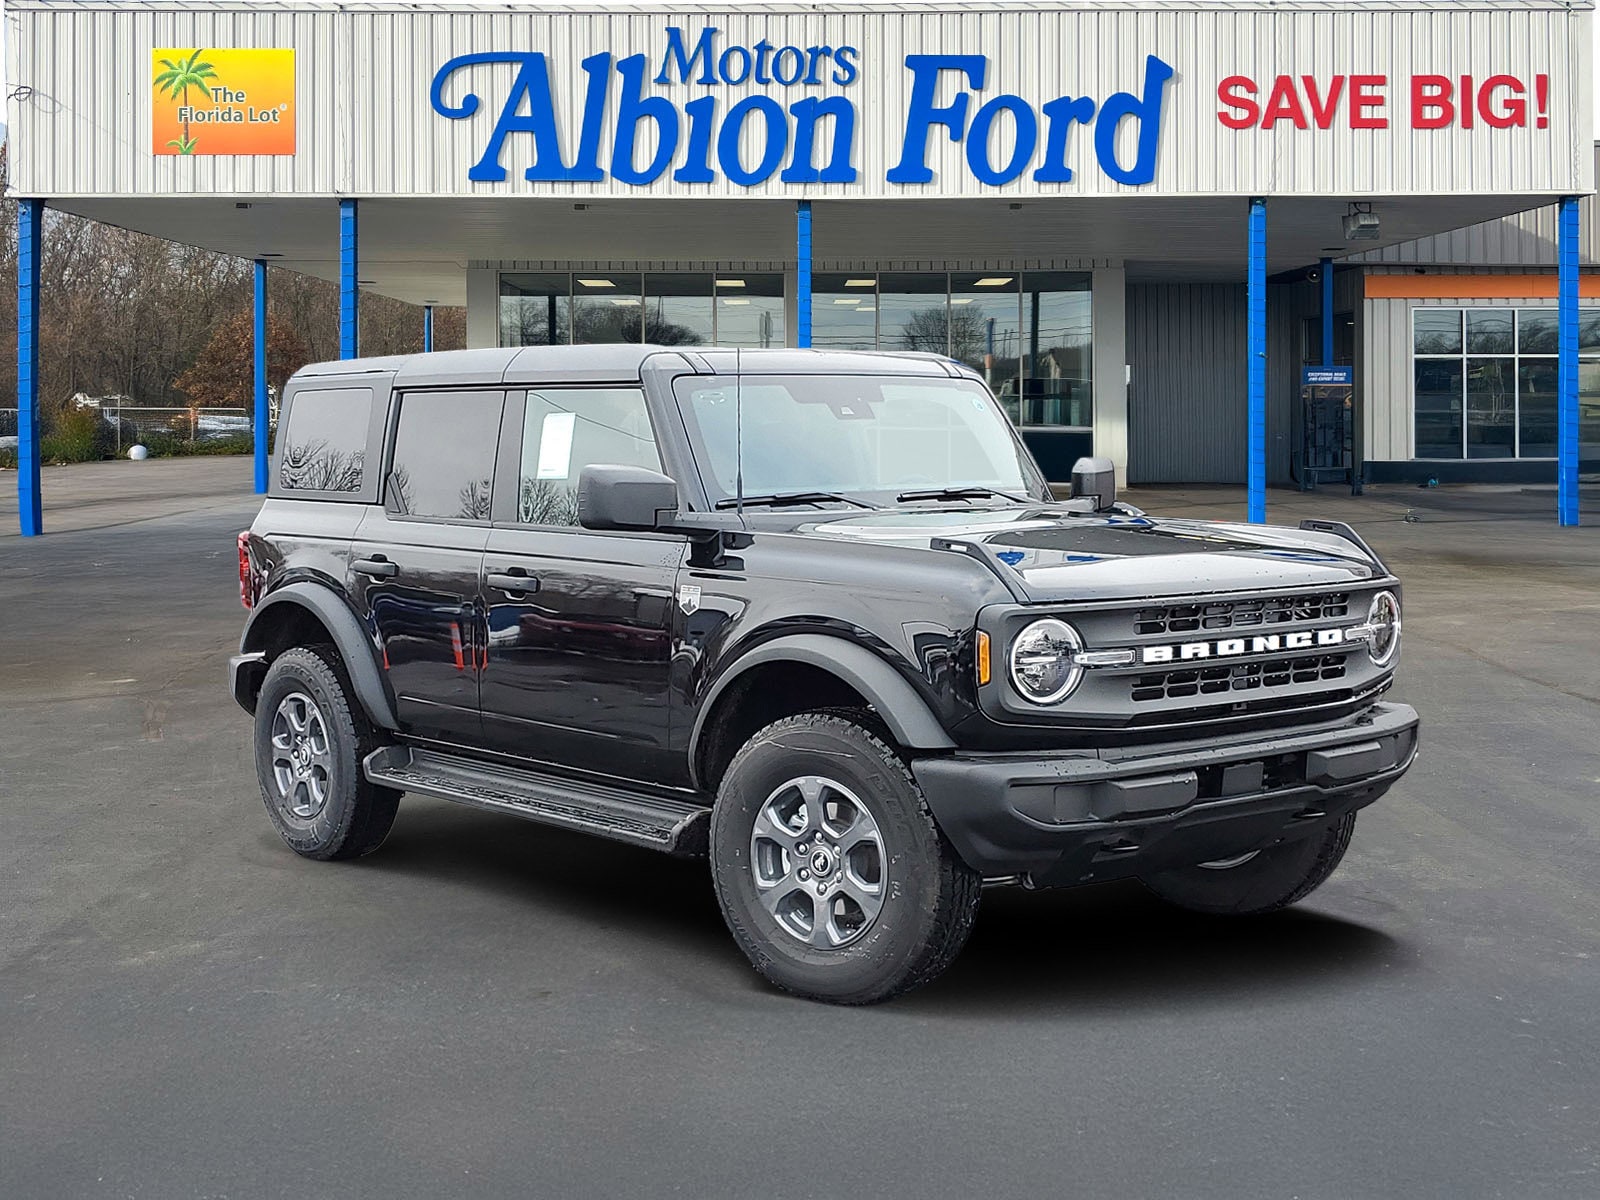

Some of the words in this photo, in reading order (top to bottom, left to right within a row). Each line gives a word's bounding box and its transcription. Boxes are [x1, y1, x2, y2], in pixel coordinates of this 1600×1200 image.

[655, 27, 857, 85] Motors
[178, 106, 243, 123] Florida
[210, 86, 246, 103] The
[1218, 75, 1387, 129] SAVE
[1412, 75, 1548, 129] BIG!
[430, 52, 857, 187] Albion
[886, 54, 1175, 186] Ford
[1142, 628, 1344, 663] BRONCO
